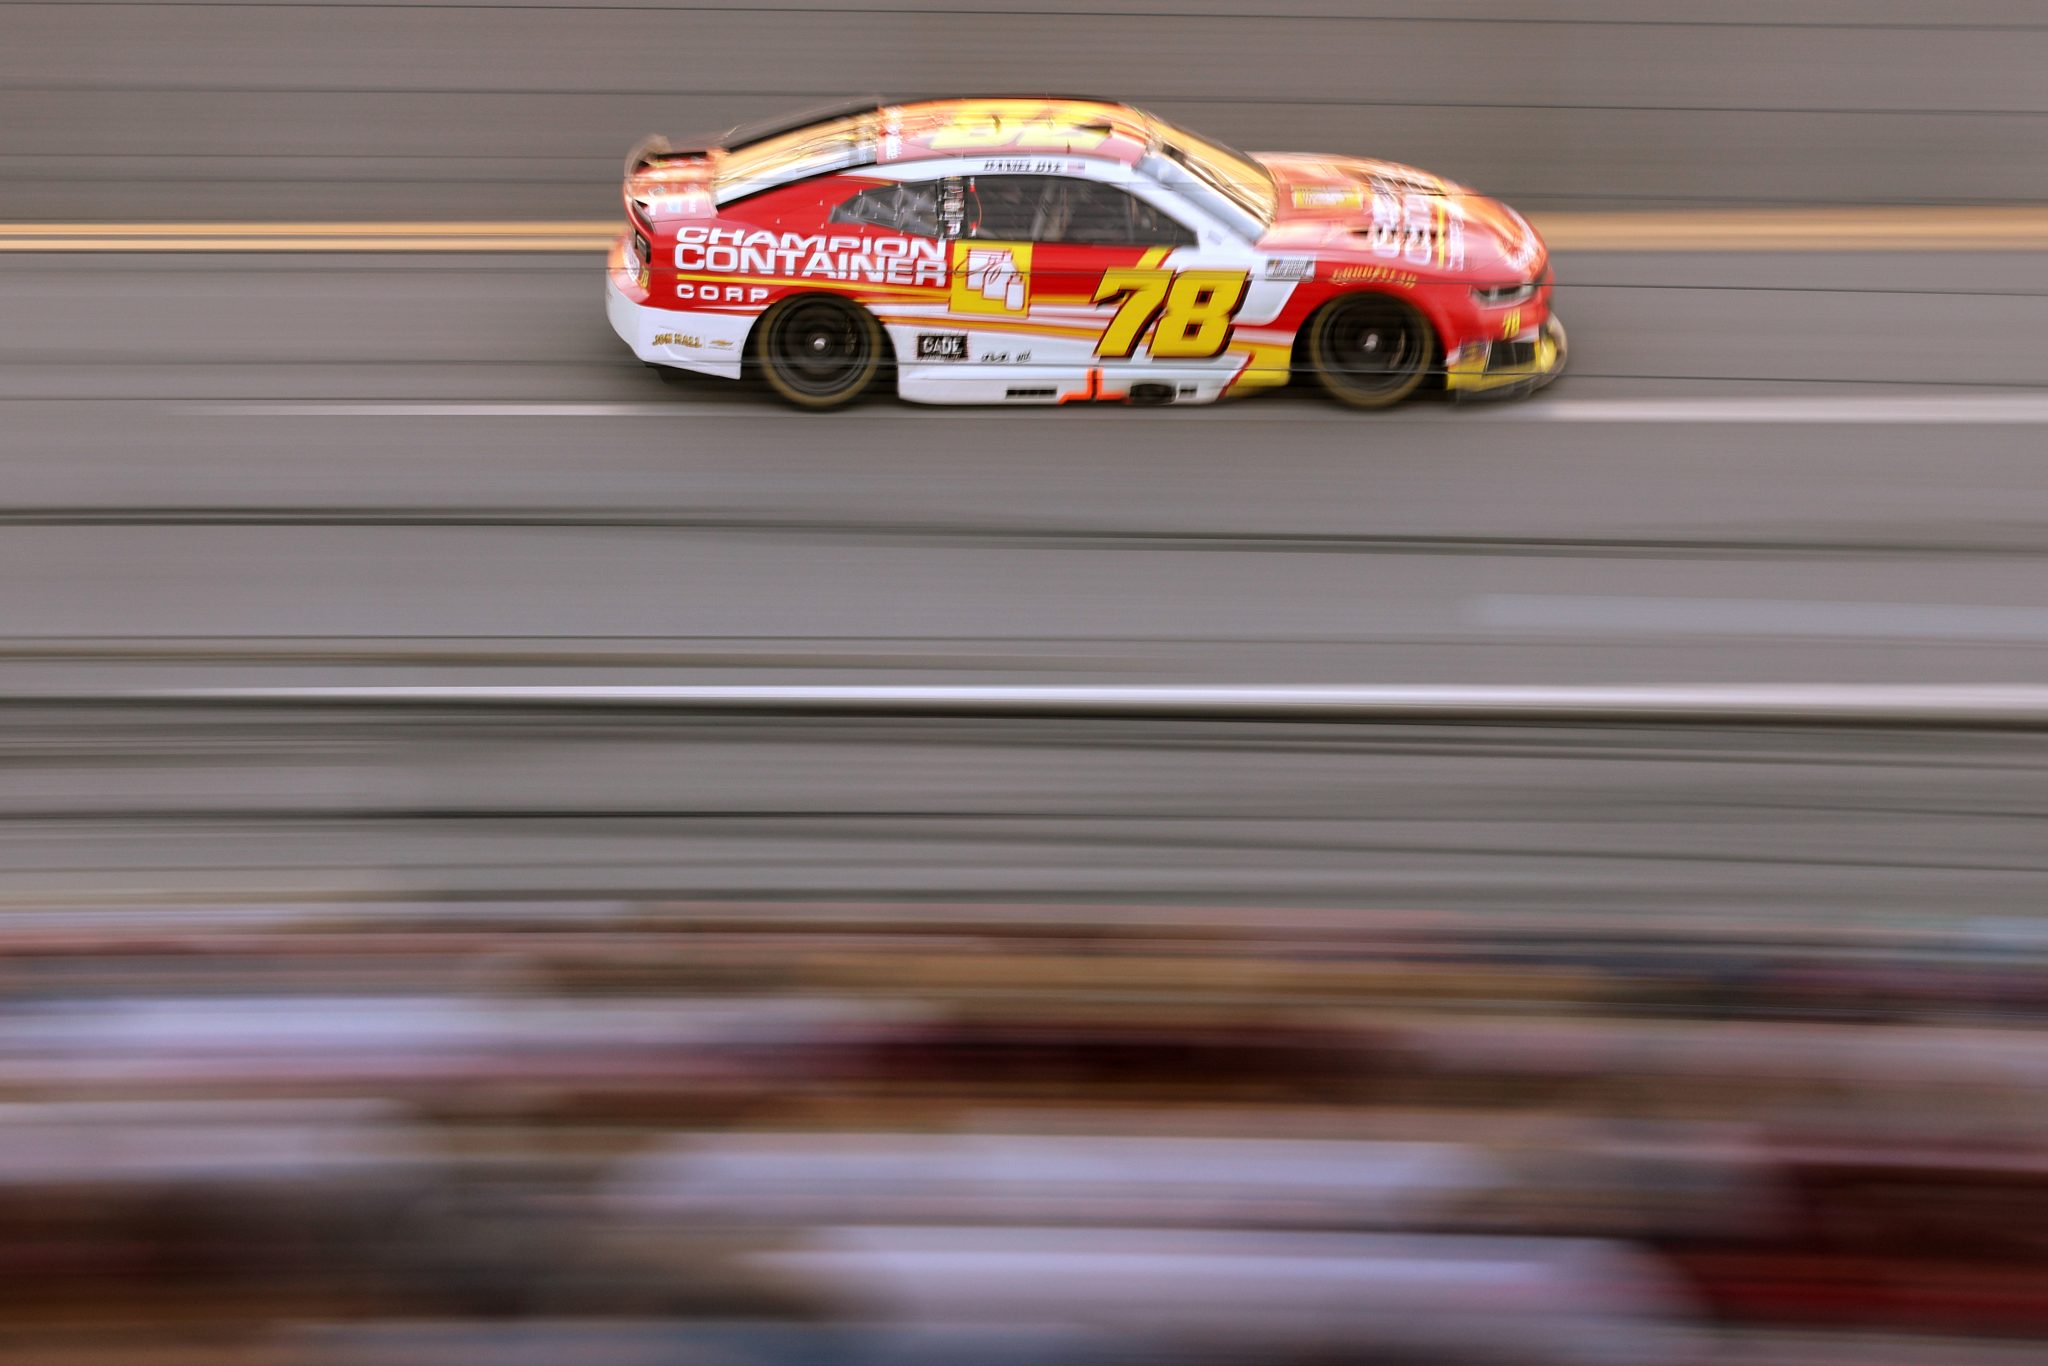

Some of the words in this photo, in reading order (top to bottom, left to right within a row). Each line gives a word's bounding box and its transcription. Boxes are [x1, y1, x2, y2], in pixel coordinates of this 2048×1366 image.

[676, 226, 946, 261] CHAMPION
[674, 243, 948, 288] CONTAINER
[676, 283, 769, 303] CORP
[1088, 267, 1254, 359] 78
